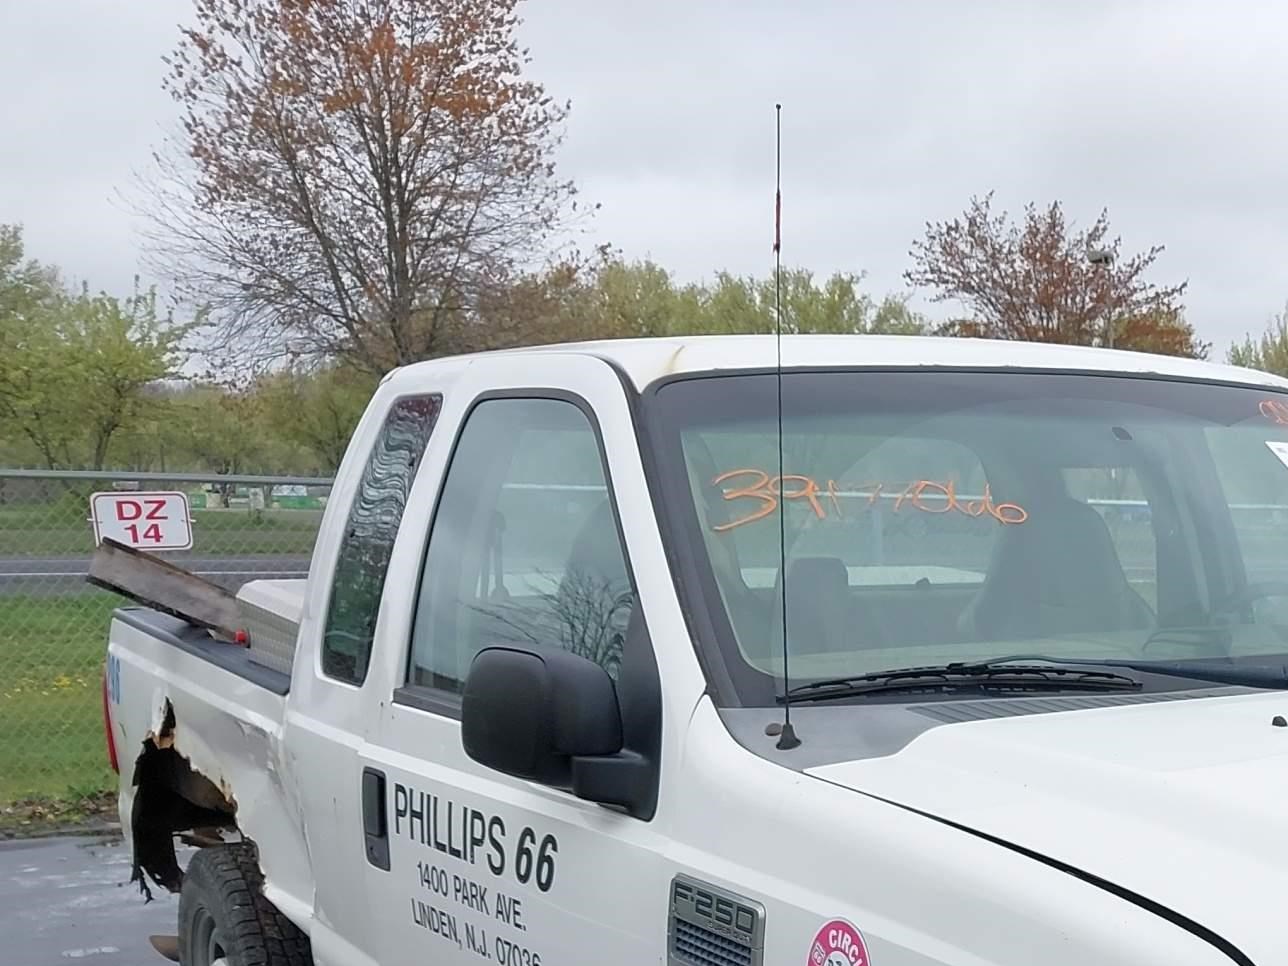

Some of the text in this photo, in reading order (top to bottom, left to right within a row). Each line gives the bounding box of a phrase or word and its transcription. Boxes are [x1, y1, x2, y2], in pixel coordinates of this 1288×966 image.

[116, 500, 168, 520] DZ
[124, 523, 163, 543] 14
[395, 783, 559, 892] PHILLIPS 66
[417, 861, 527, 931] 1400 PARK AVE.
[411, 898, 462, 949] LINDEN,
[465, 922, 491, 959] N.J.
